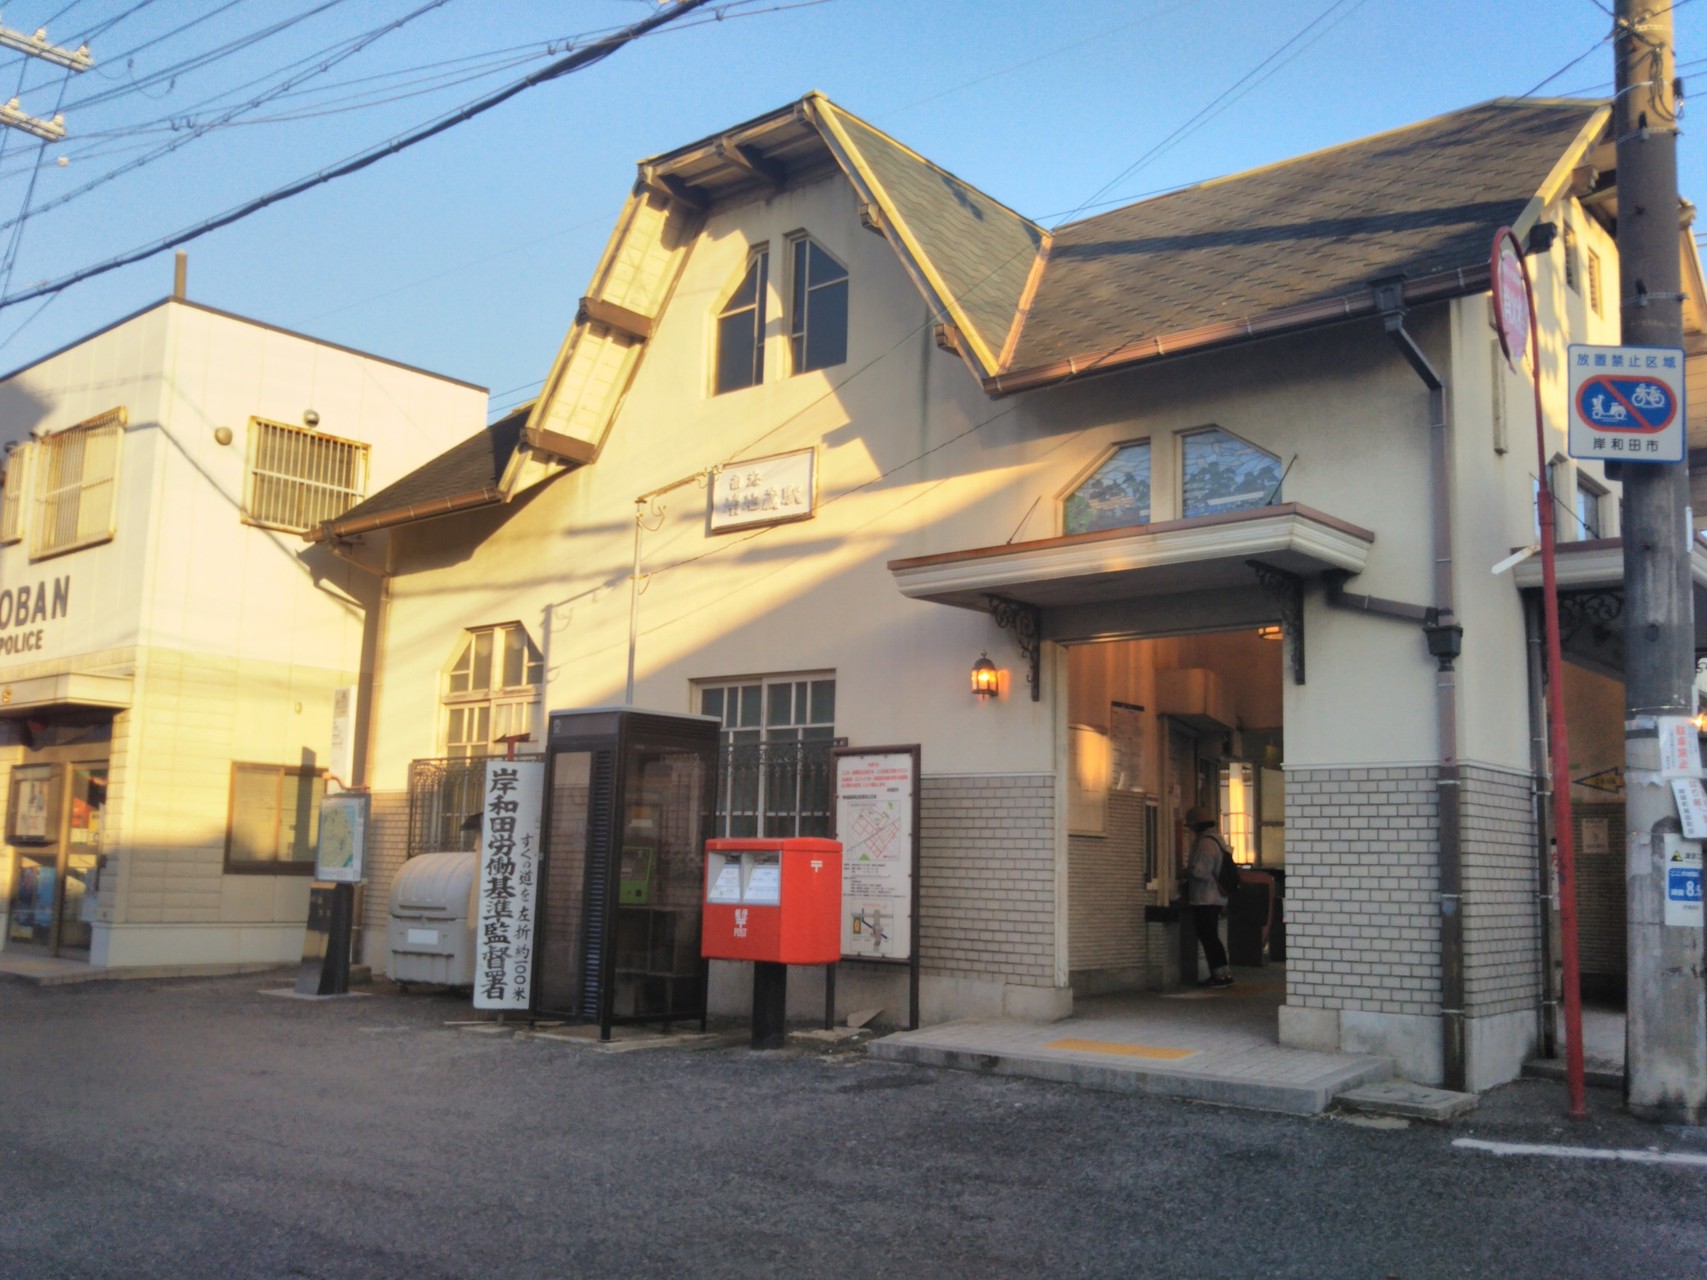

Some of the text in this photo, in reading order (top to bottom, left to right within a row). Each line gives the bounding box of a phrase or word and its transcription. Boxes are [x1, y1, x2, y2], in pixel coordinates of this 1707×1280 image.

[1577, 353, 1676, 369] 放置禁止区域
[1593, 437, 1659, 452] 岸和田市
[0, 575, 70, 630] OBAN
[481, 767, 519, 1001] 岸和田労働基準監督署
